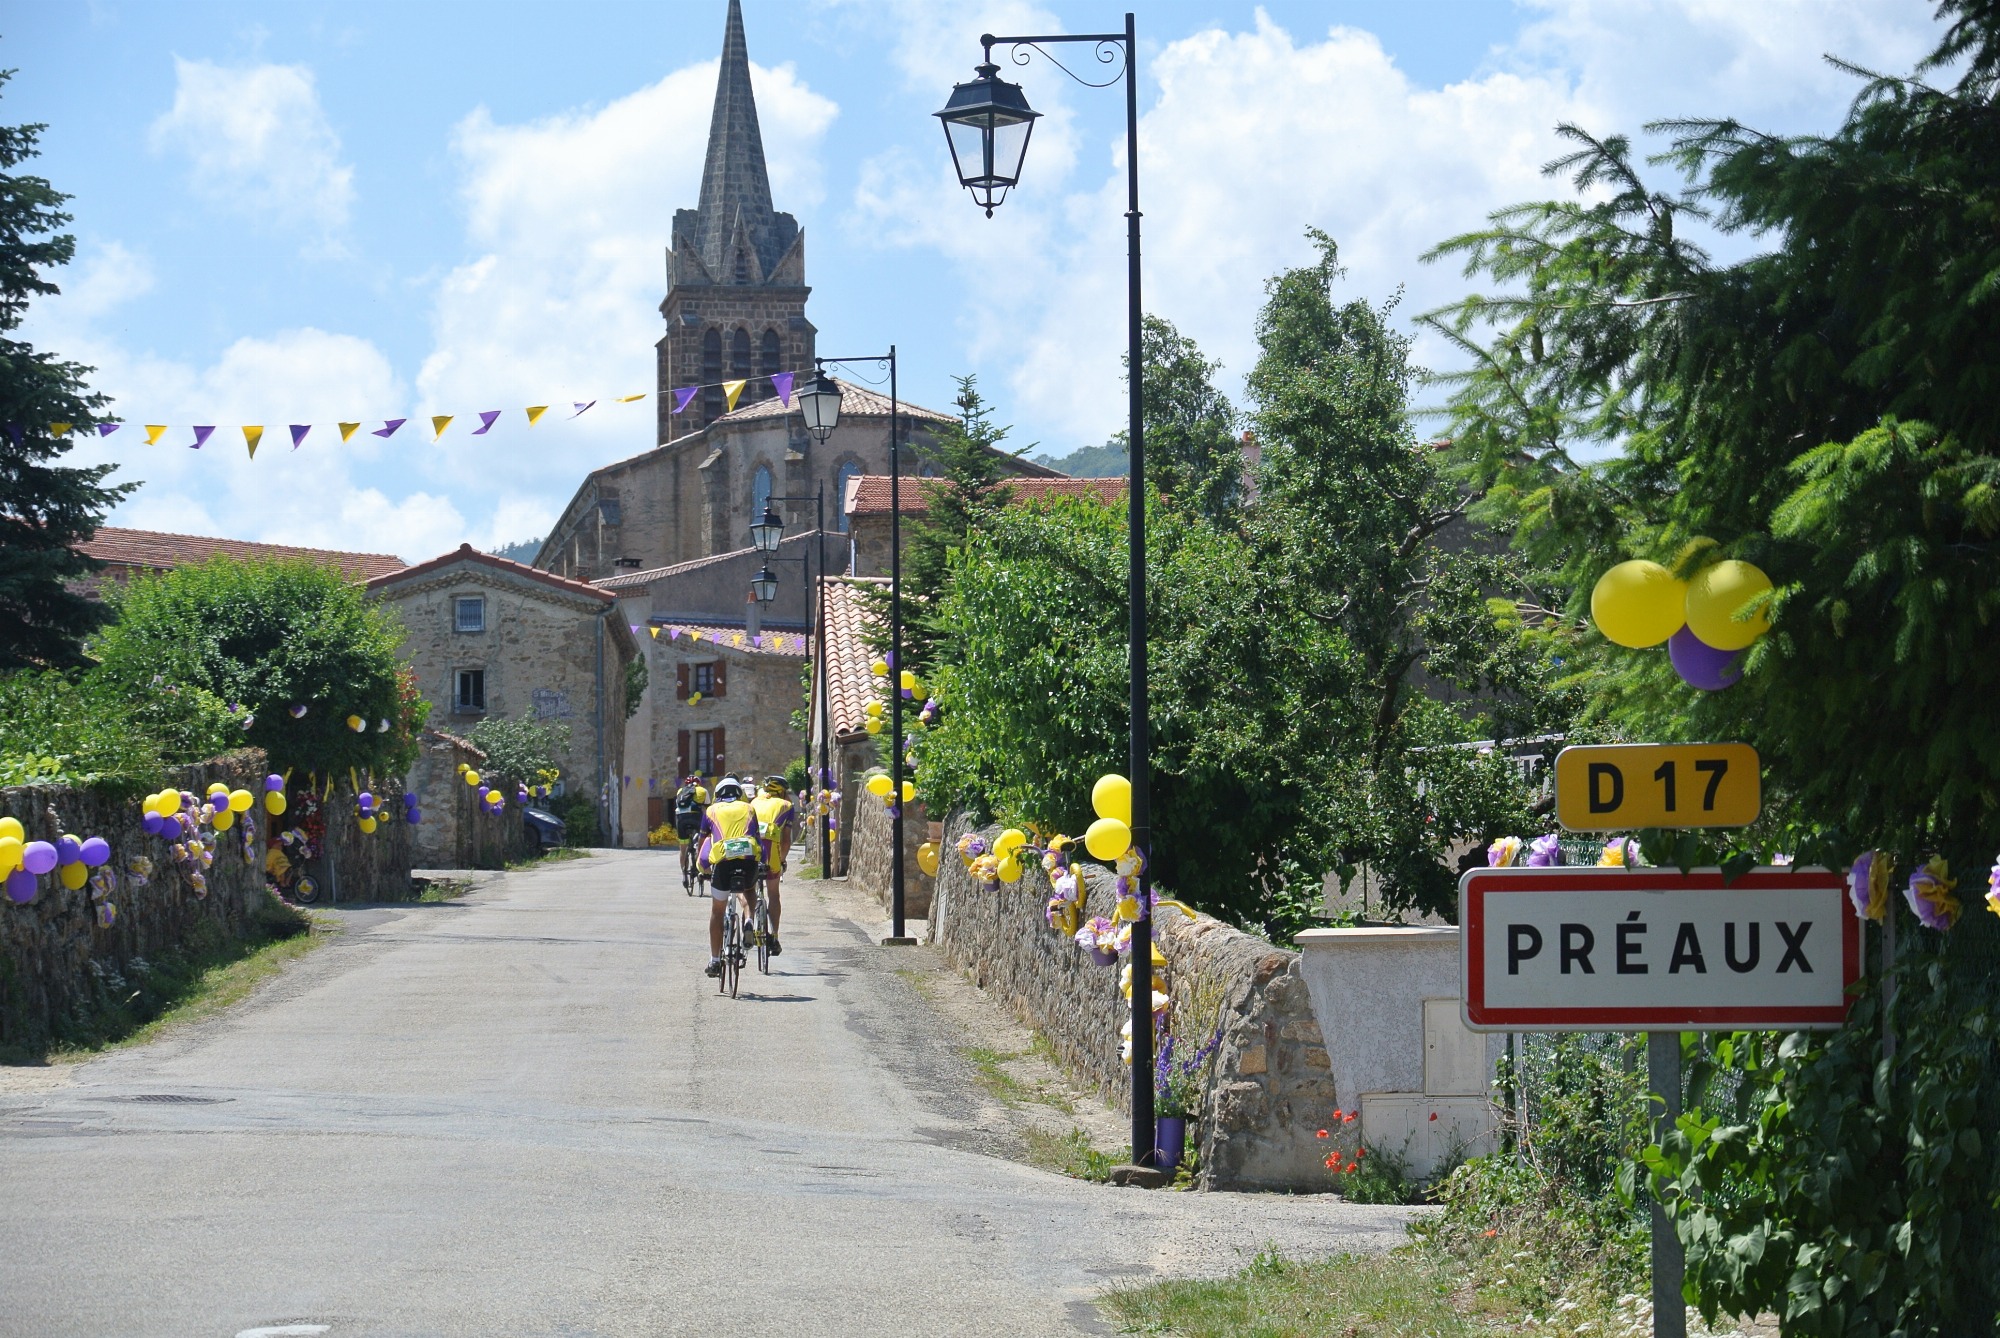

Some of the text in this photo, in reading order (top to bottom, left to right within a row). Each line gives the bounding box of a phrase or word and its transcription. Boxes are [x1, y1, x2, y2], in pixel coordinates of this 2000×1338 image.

[1588, 759, 1729, 814] D 17
[1507, 910, 1815, 975] PRÉAUX
